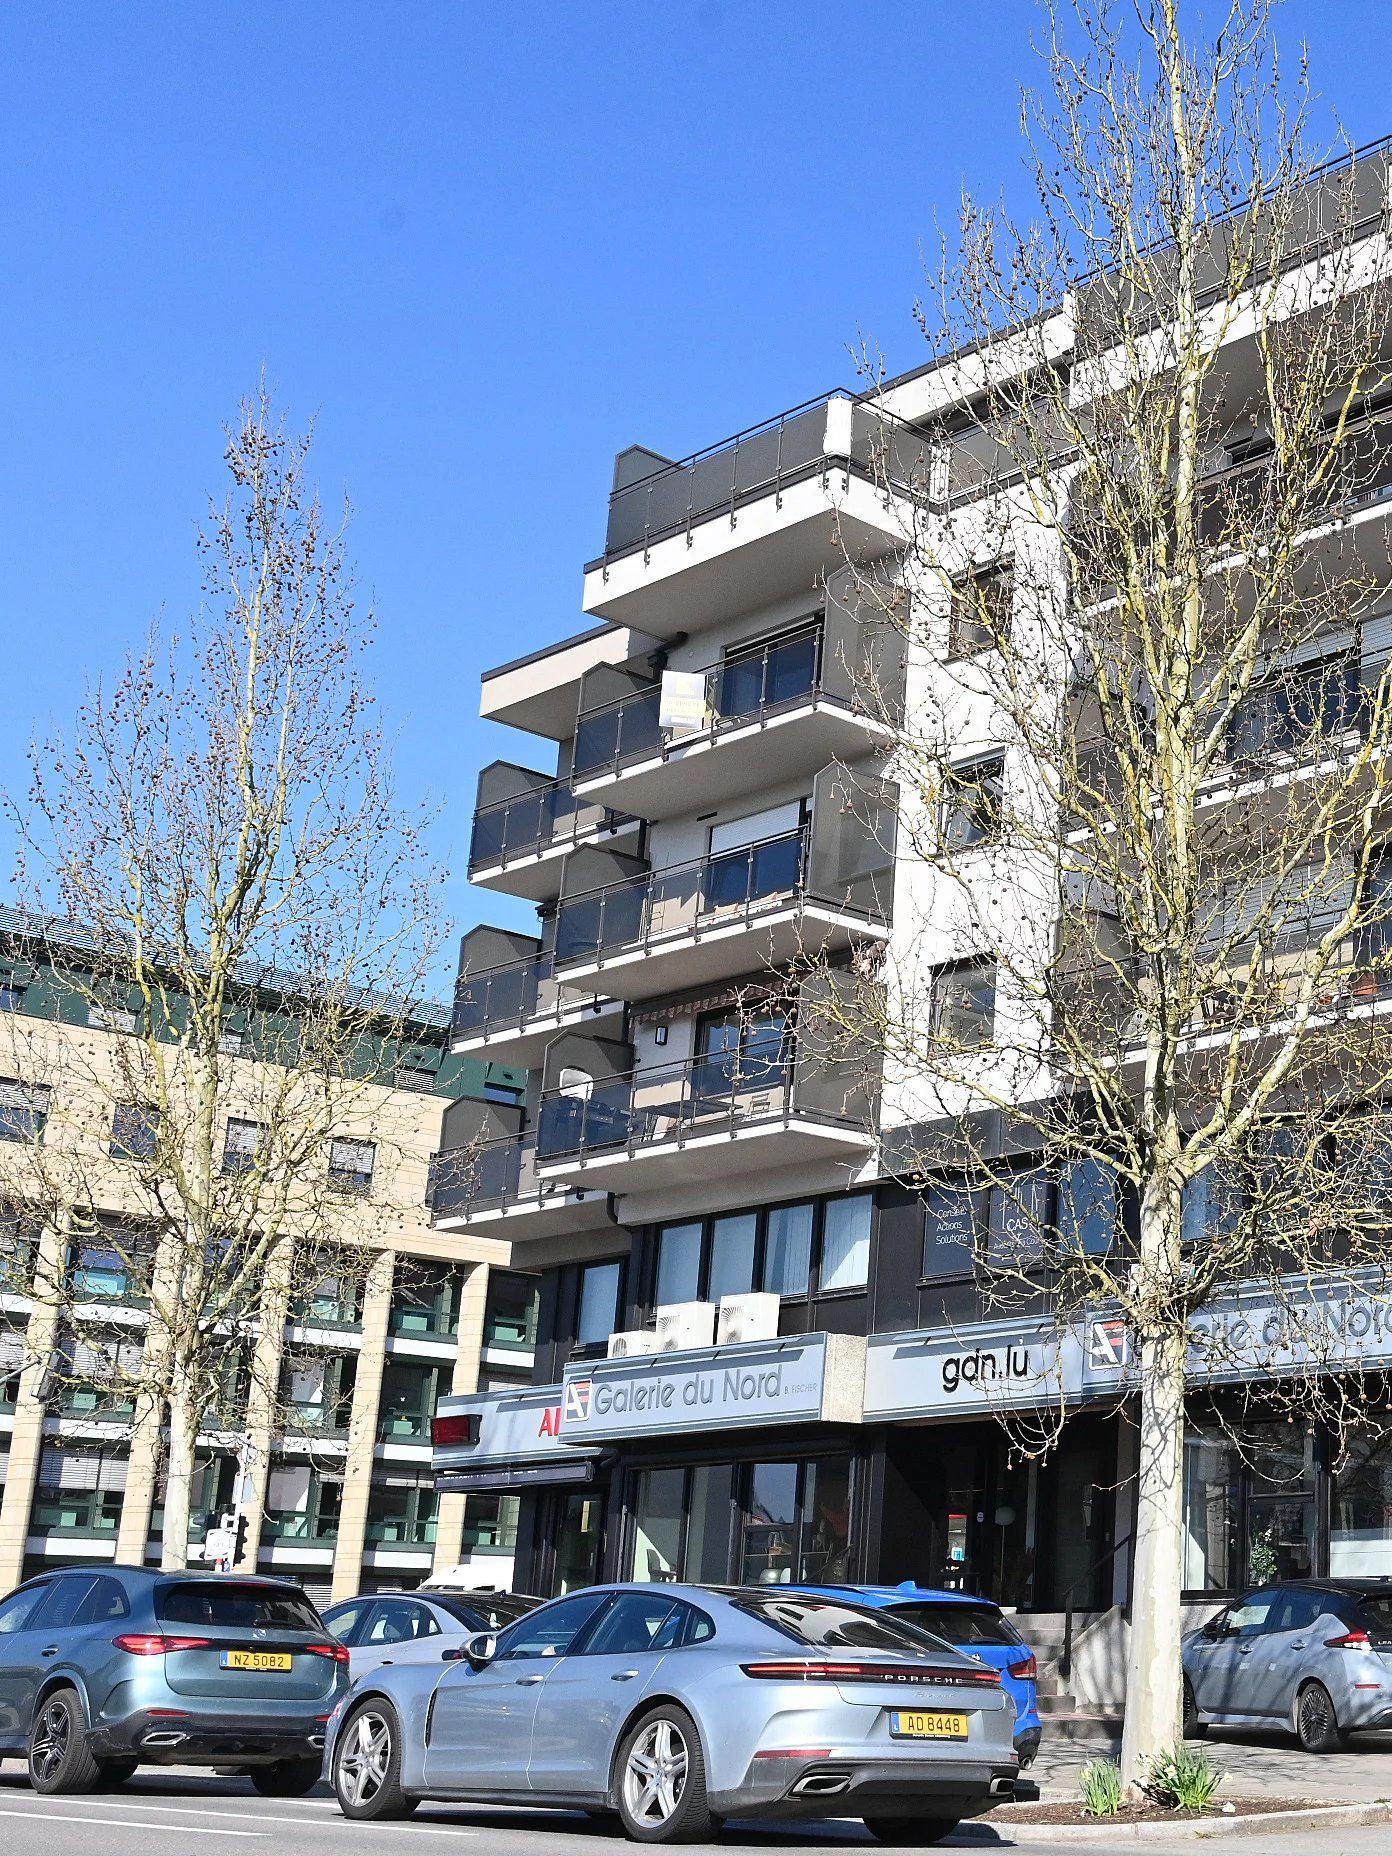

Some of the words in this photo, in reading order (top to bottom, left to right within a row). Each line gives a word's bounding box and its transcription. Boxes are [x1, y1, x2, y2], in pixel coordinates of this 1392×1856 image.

[936, 1234, 968, 1244] Solutions
[943, 1344, 1029, 1393] gdn.lu
[595, 1377, 676, 1414] Galerie
[683, 1372, 714, 1406] du
[723, 1364, 782, 1401] Nord
[791, 1382, 818, 1394] FISCHER
[234, 1654, 250, 1666] NZ
[253, 1655, 284, 1667] 5082
[884, 1674, 963, 1684] PORSCHE
[908, 1715, 924, 1731] AD
[927, 1717, 960, 1733] 8448
